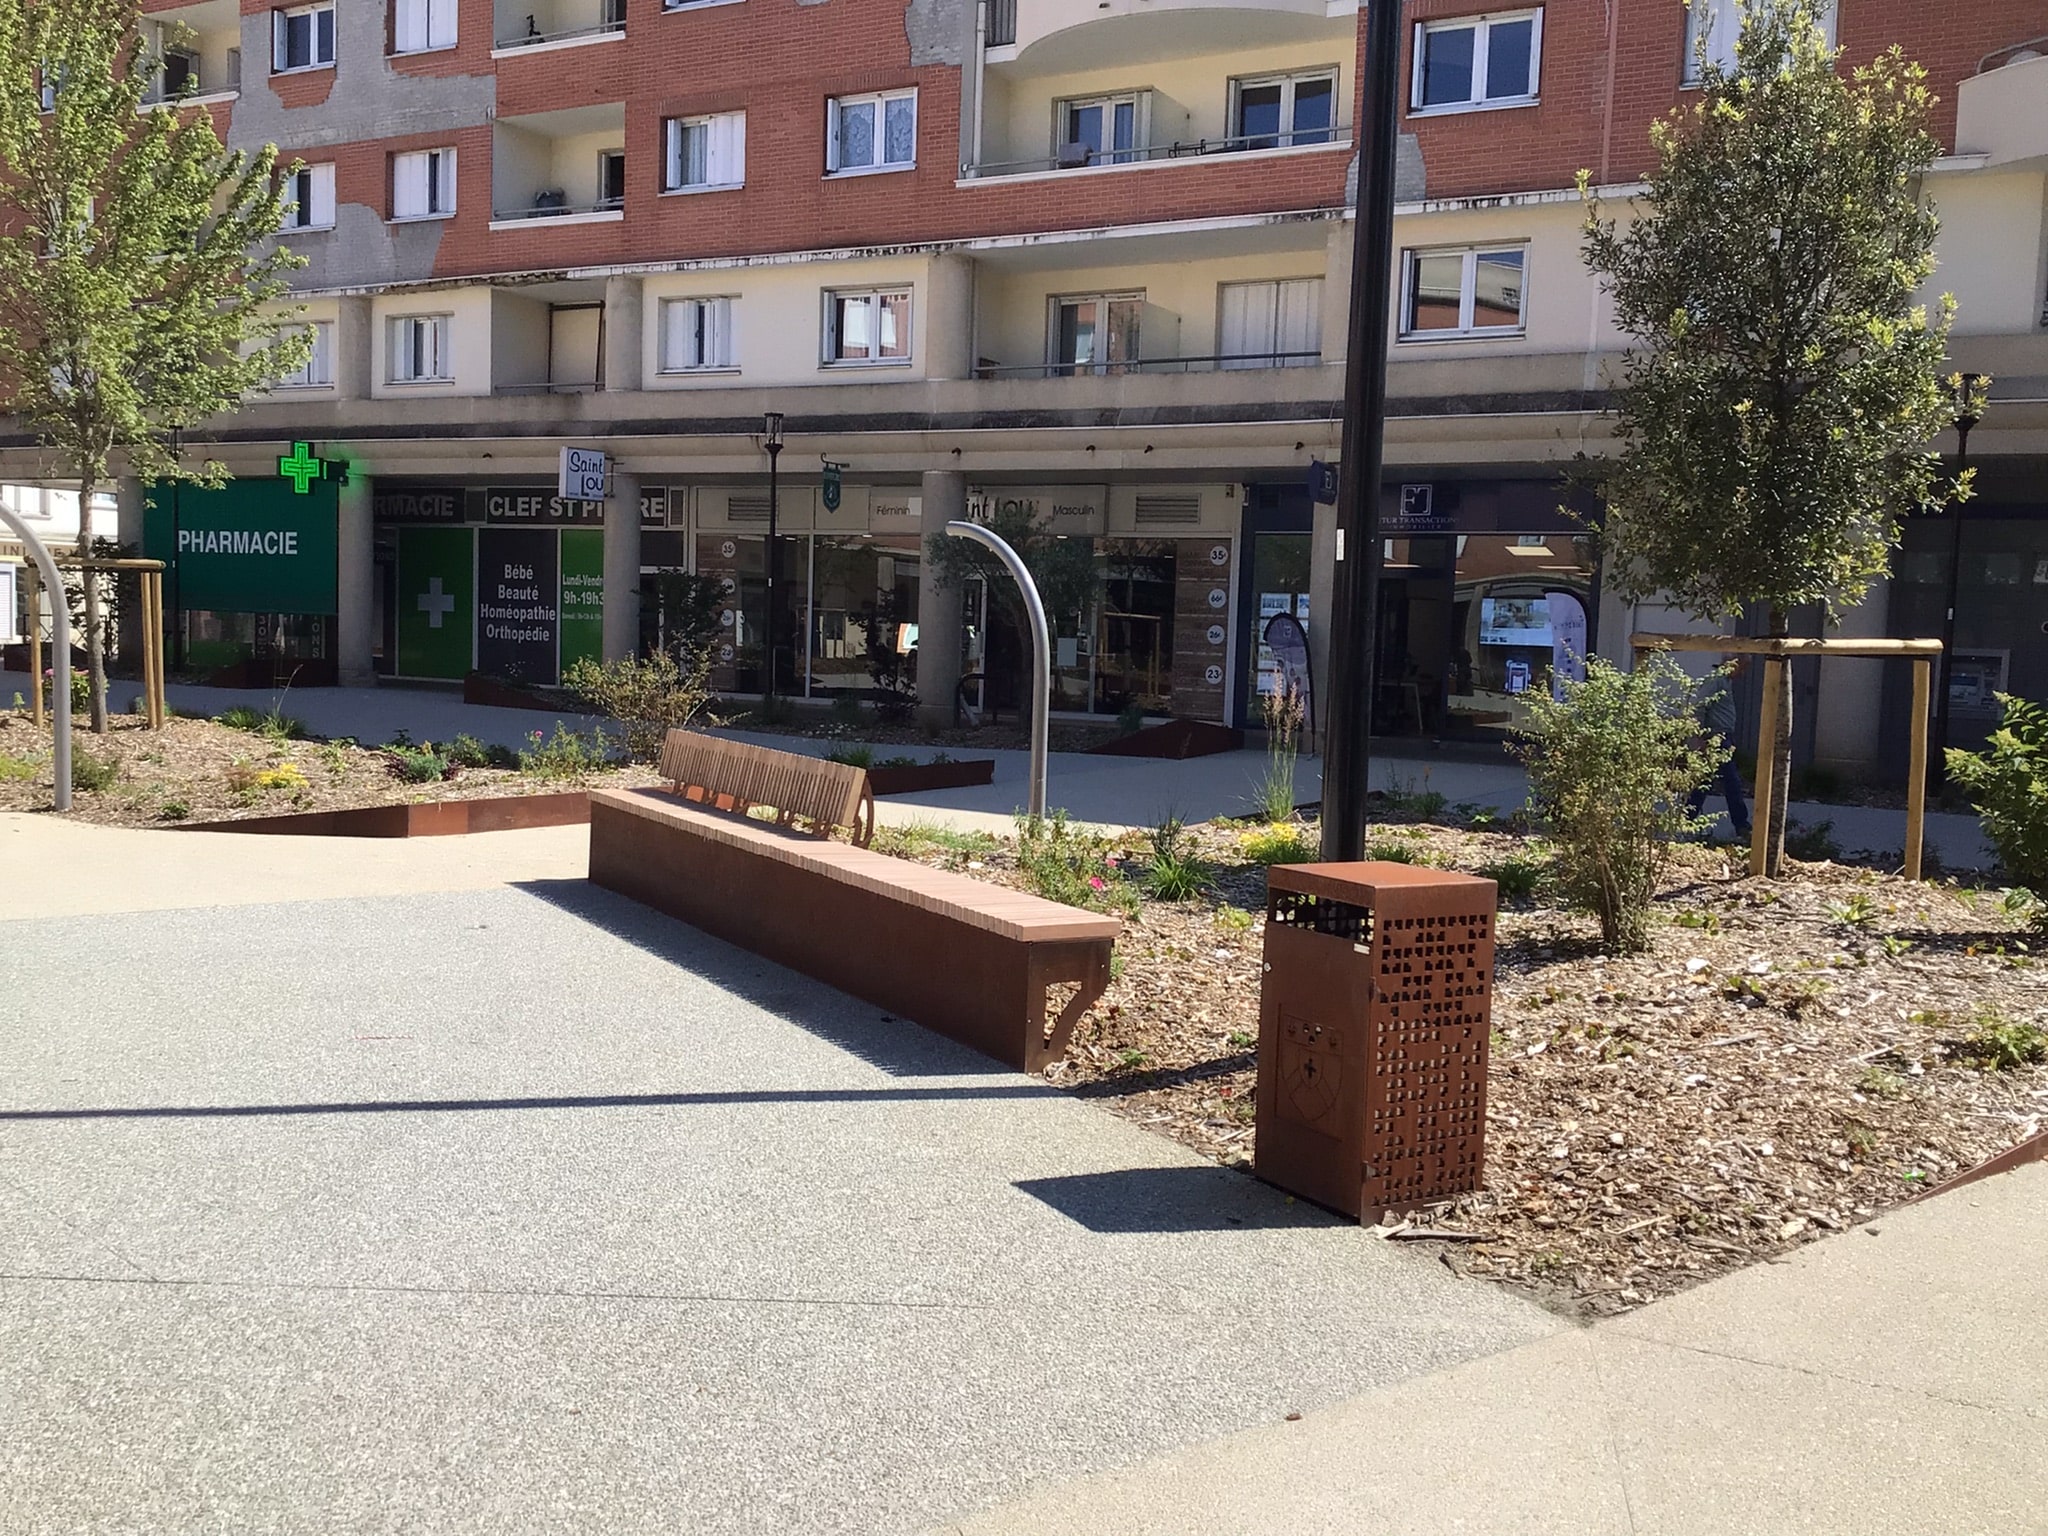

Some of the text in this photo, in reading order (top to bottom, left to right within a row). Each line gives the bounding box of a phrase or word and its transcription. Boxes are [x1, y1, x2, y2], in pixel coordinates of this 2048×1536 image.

[569, 451, 604, 473] Saint
[373, 495, 455, 517] RMACIE
[489, 496, 665, 518] CLEF ST PIRE
[966, 496, 990, 519] int
[1053, 505, 1095, 517] Masculin
[178, 528, 298, 556] PHARMACIE
[504, 563, 533, 579] Bébé
[562, 574, 603, 585] Lundi-Vendr
[498, 585, 539, 601] Beauté
[563, 590, 604, 605] 9h-19h3
[480, 602, 556, 623] Homéopathie
[486, 623, 550, 643] Orthopédie
